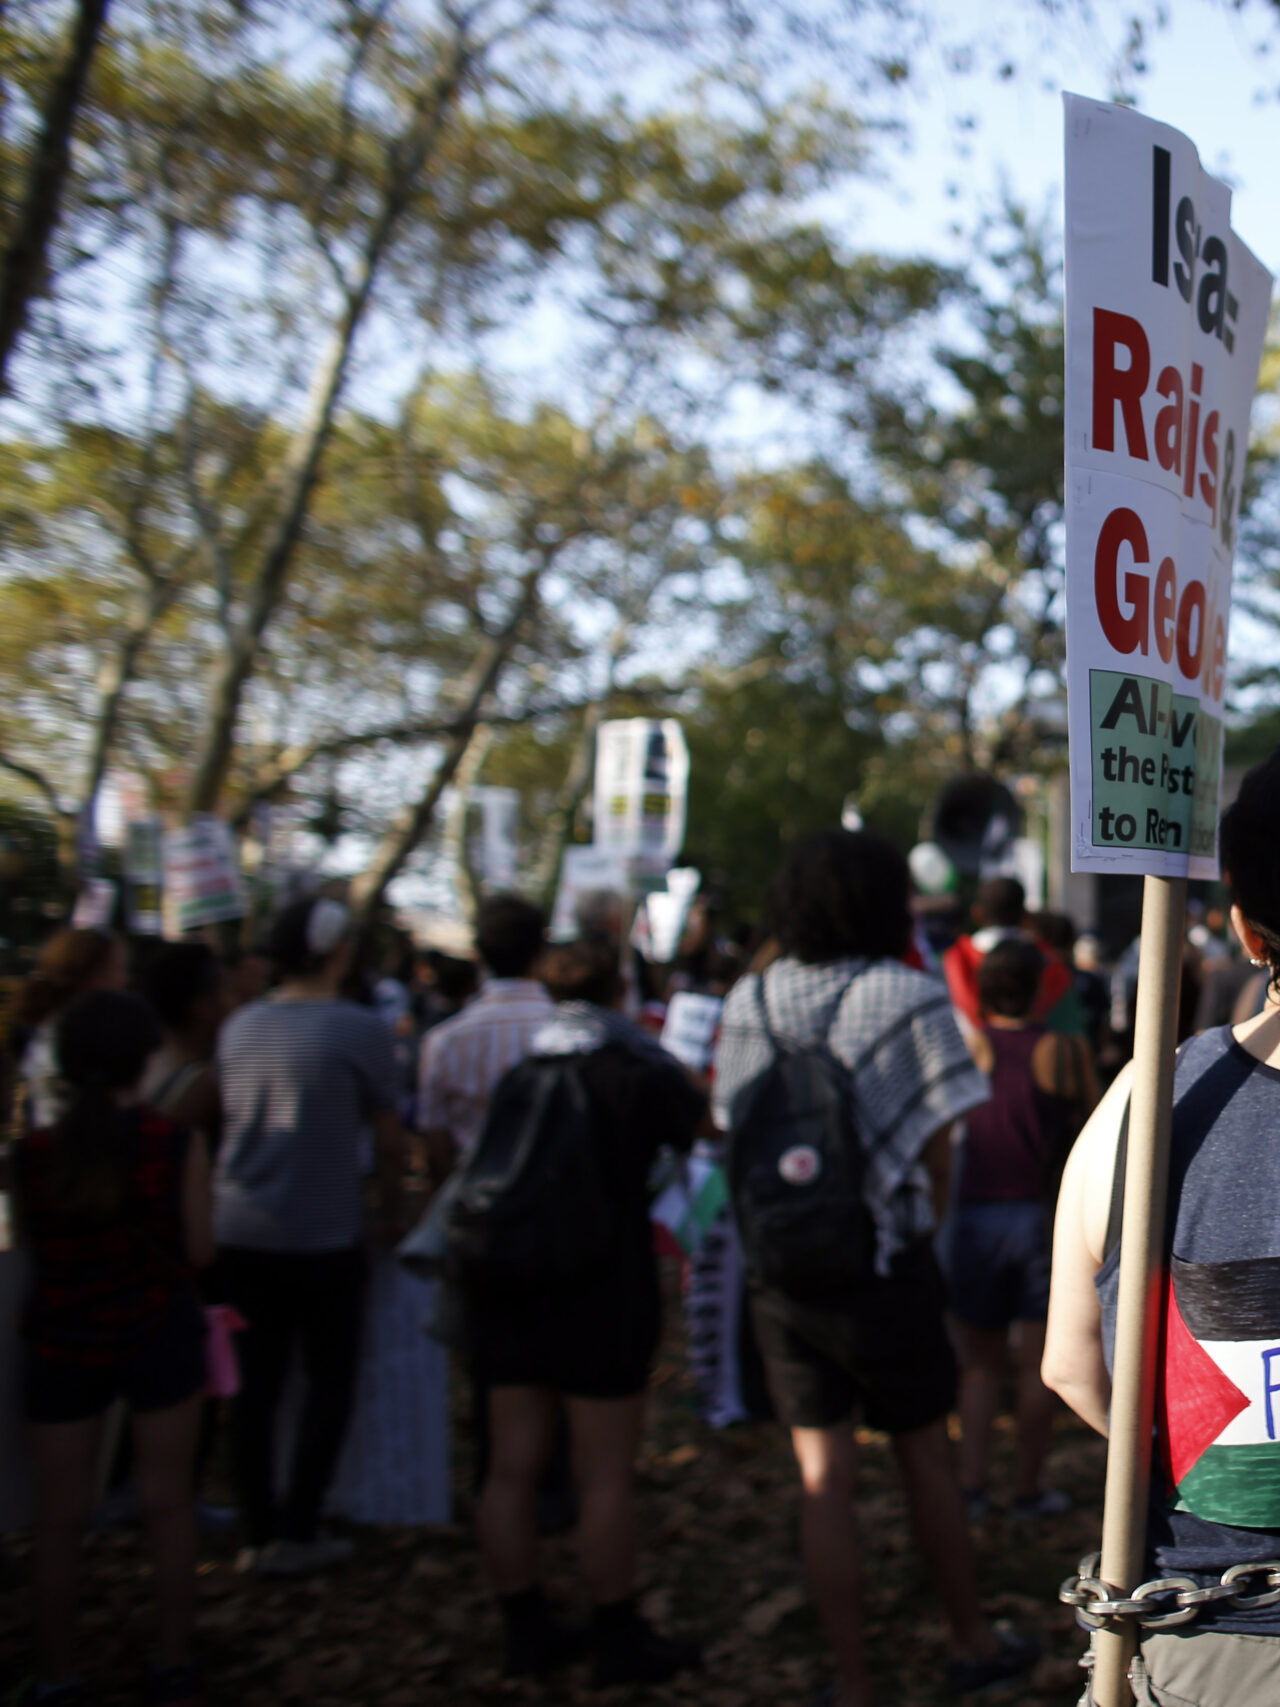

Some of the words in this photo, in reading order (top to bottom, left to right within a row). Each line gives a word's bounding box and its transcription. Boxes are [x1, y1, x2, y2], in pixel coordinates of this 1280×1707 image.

[1093, 306, 1220, 528] Rais
[1101, 746, 1156, 786] the
[1098, 807, 1137, 842] to
[1145, 808, 1182, 848] Ren
